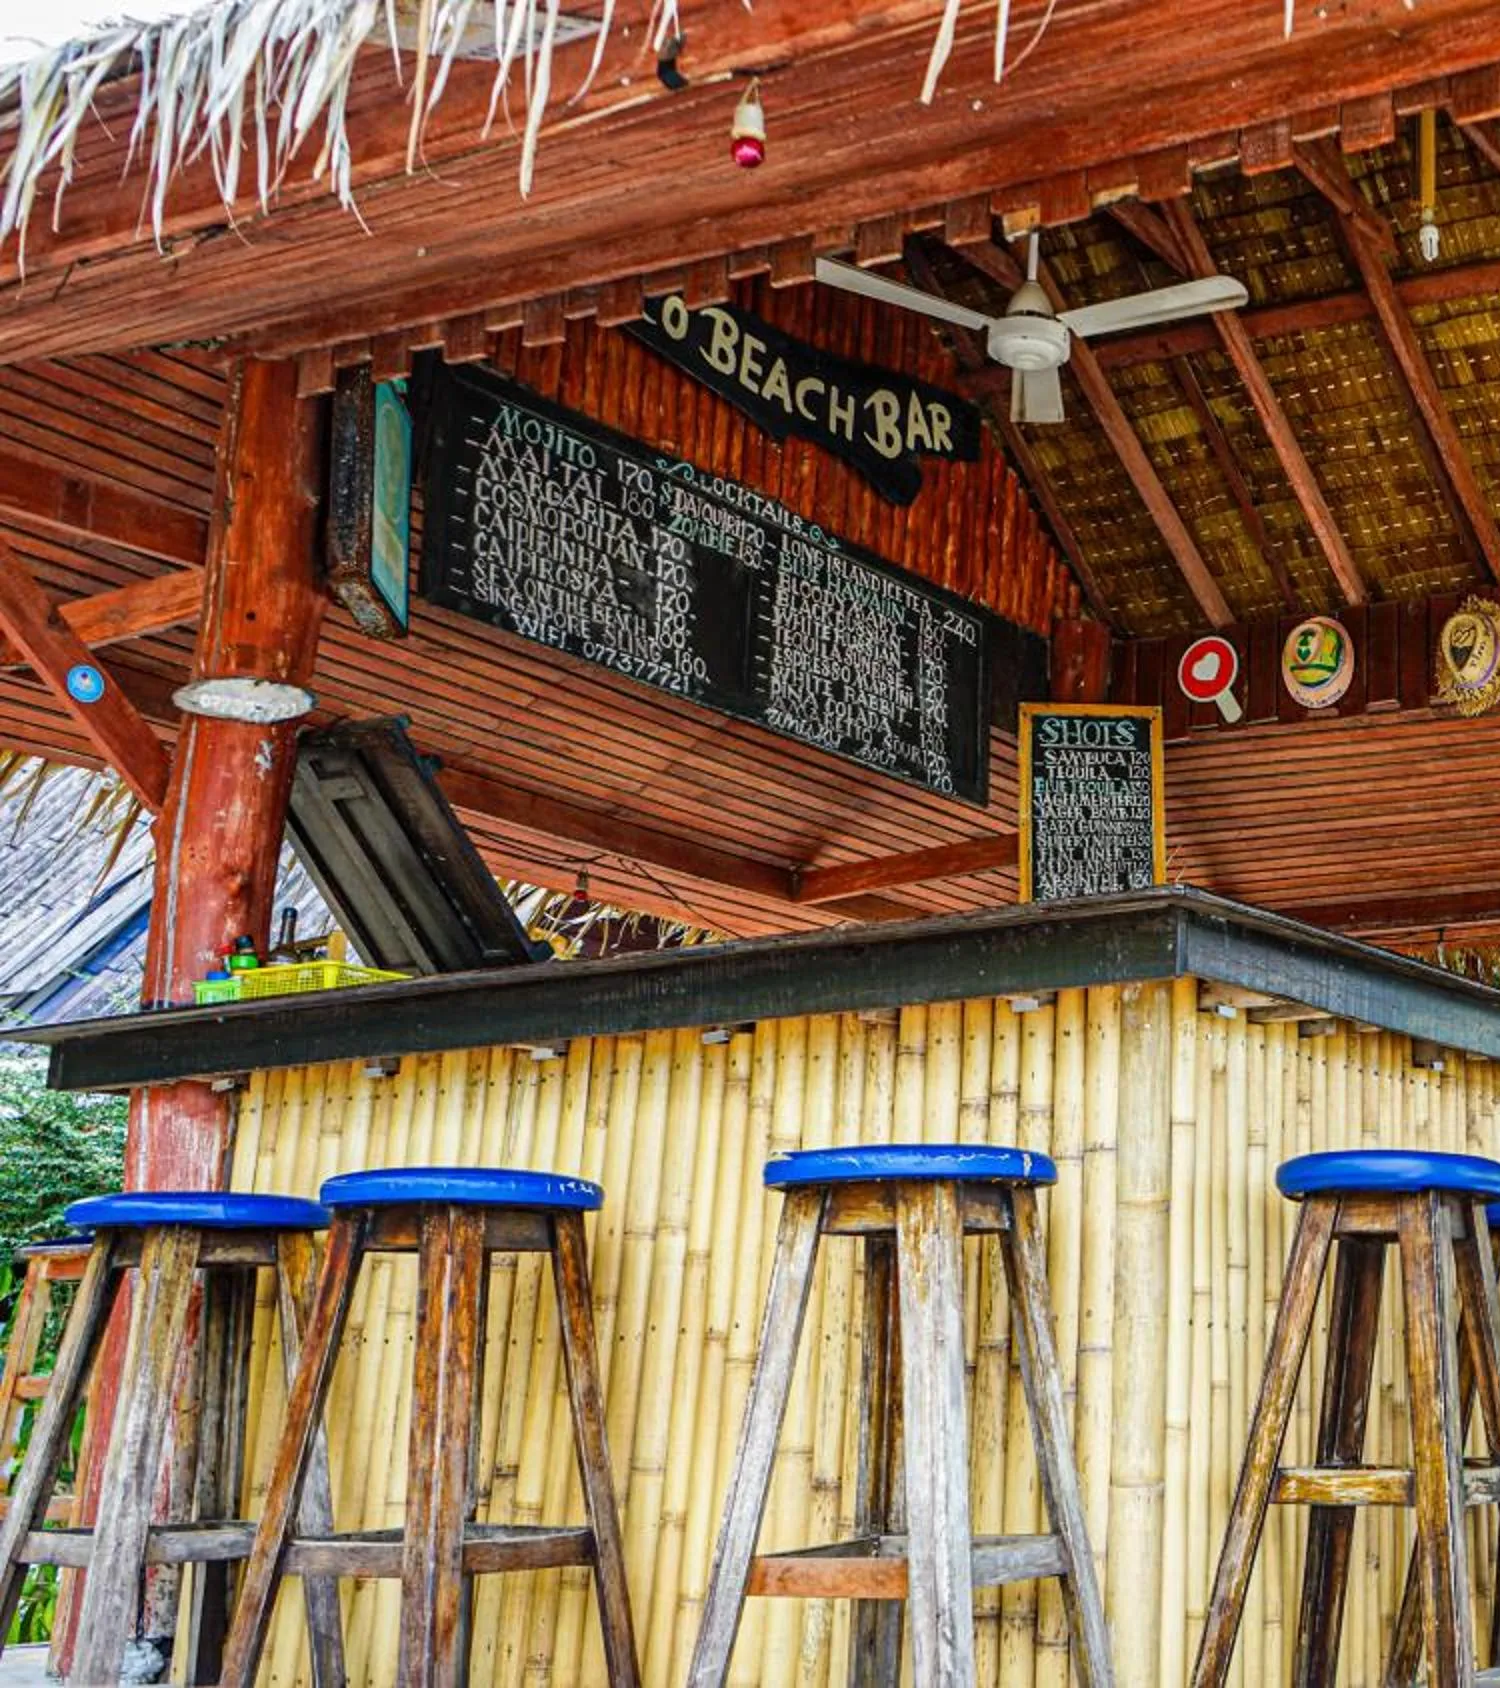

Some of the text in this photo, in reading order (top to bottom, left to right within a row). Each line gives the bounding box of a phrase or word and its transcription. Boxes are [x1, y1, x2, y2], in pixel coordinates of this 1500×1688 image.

[699, 306, 855, 441] BEACH
[863, 388, 954, 460] BAR
[494, 404, 596, 469] MOJITO
[475, 477, 646, 571] COSMOPOLITAN
[476, 451, 639, 545] MARGARITA
[472, 556, 520, 596] SEX
[474, 501, 614, 580] CAIPIRINHA
[474, 531, 619, 608] CAIPIROSKA
[472, 579, 591, 640] SINGAPORE
[601, 619, 664, 663] SLING
[583, 641, 690, 694] 077377721
[1038, 717, 1137, 747] SHOTS
[1044, 749, 1126, 767] SAMBUCA
[1045, 765, 1111, 781] TEQUILA
